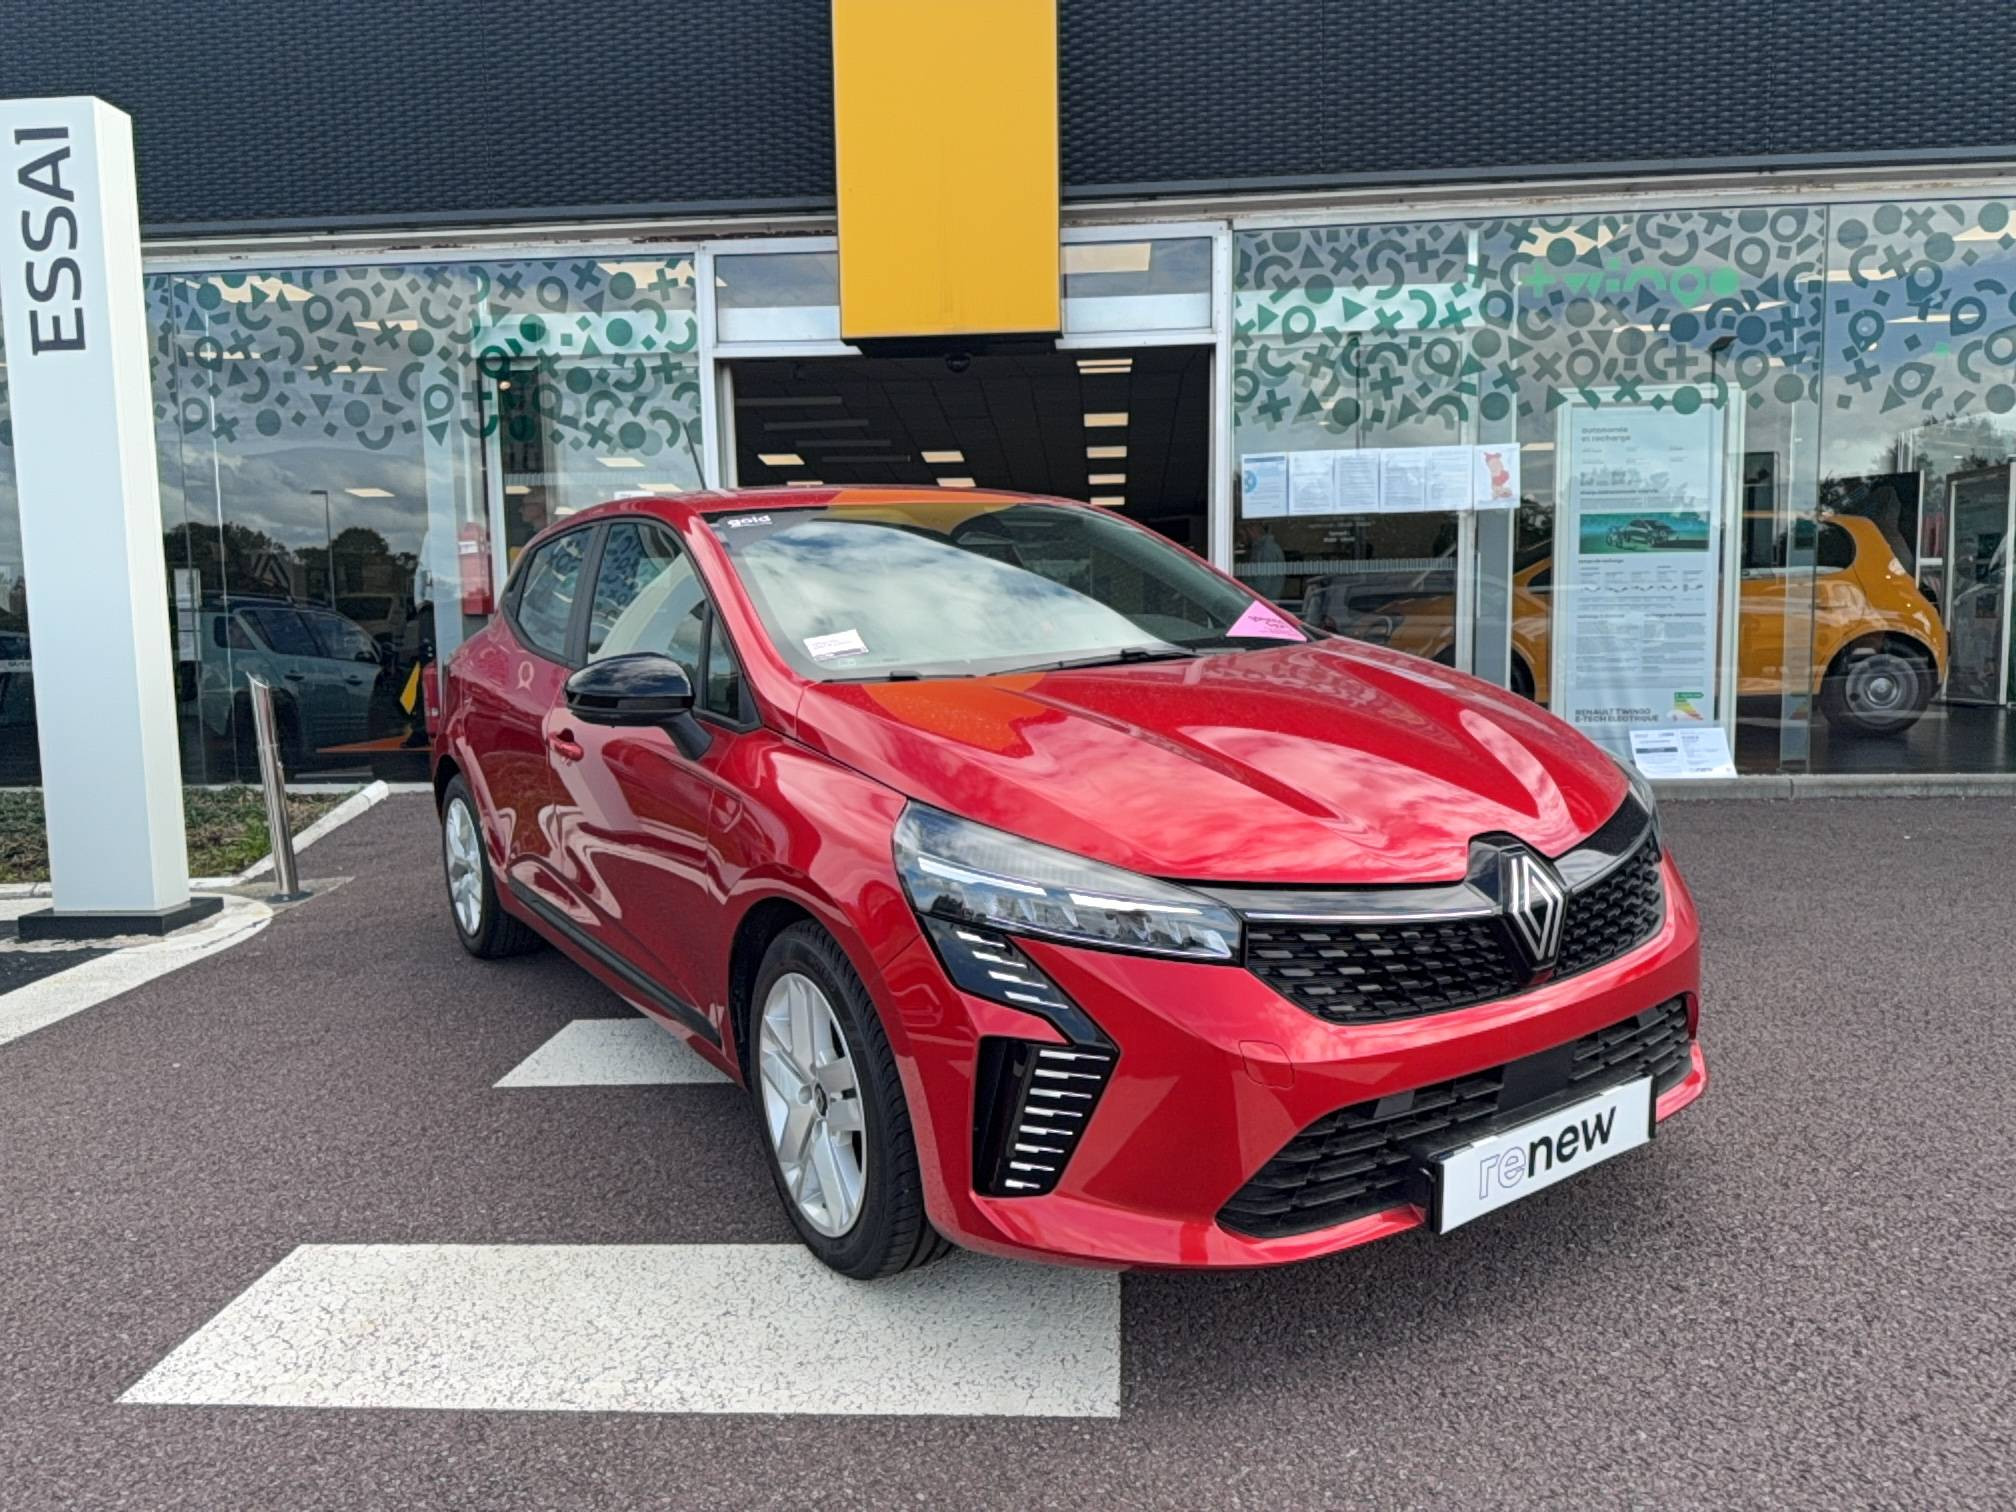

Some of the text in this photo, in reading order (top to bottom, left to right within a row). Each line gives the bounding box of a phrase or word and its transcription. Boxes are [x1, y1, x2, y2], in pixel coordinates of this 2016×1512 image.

[14, 127, 86, 356] ESSAI
[1592, 434, 1631, 443] recharge
[1616, 707, 1650, 715] TWINGO
[1479, 1106, 1616, 1200] renew
